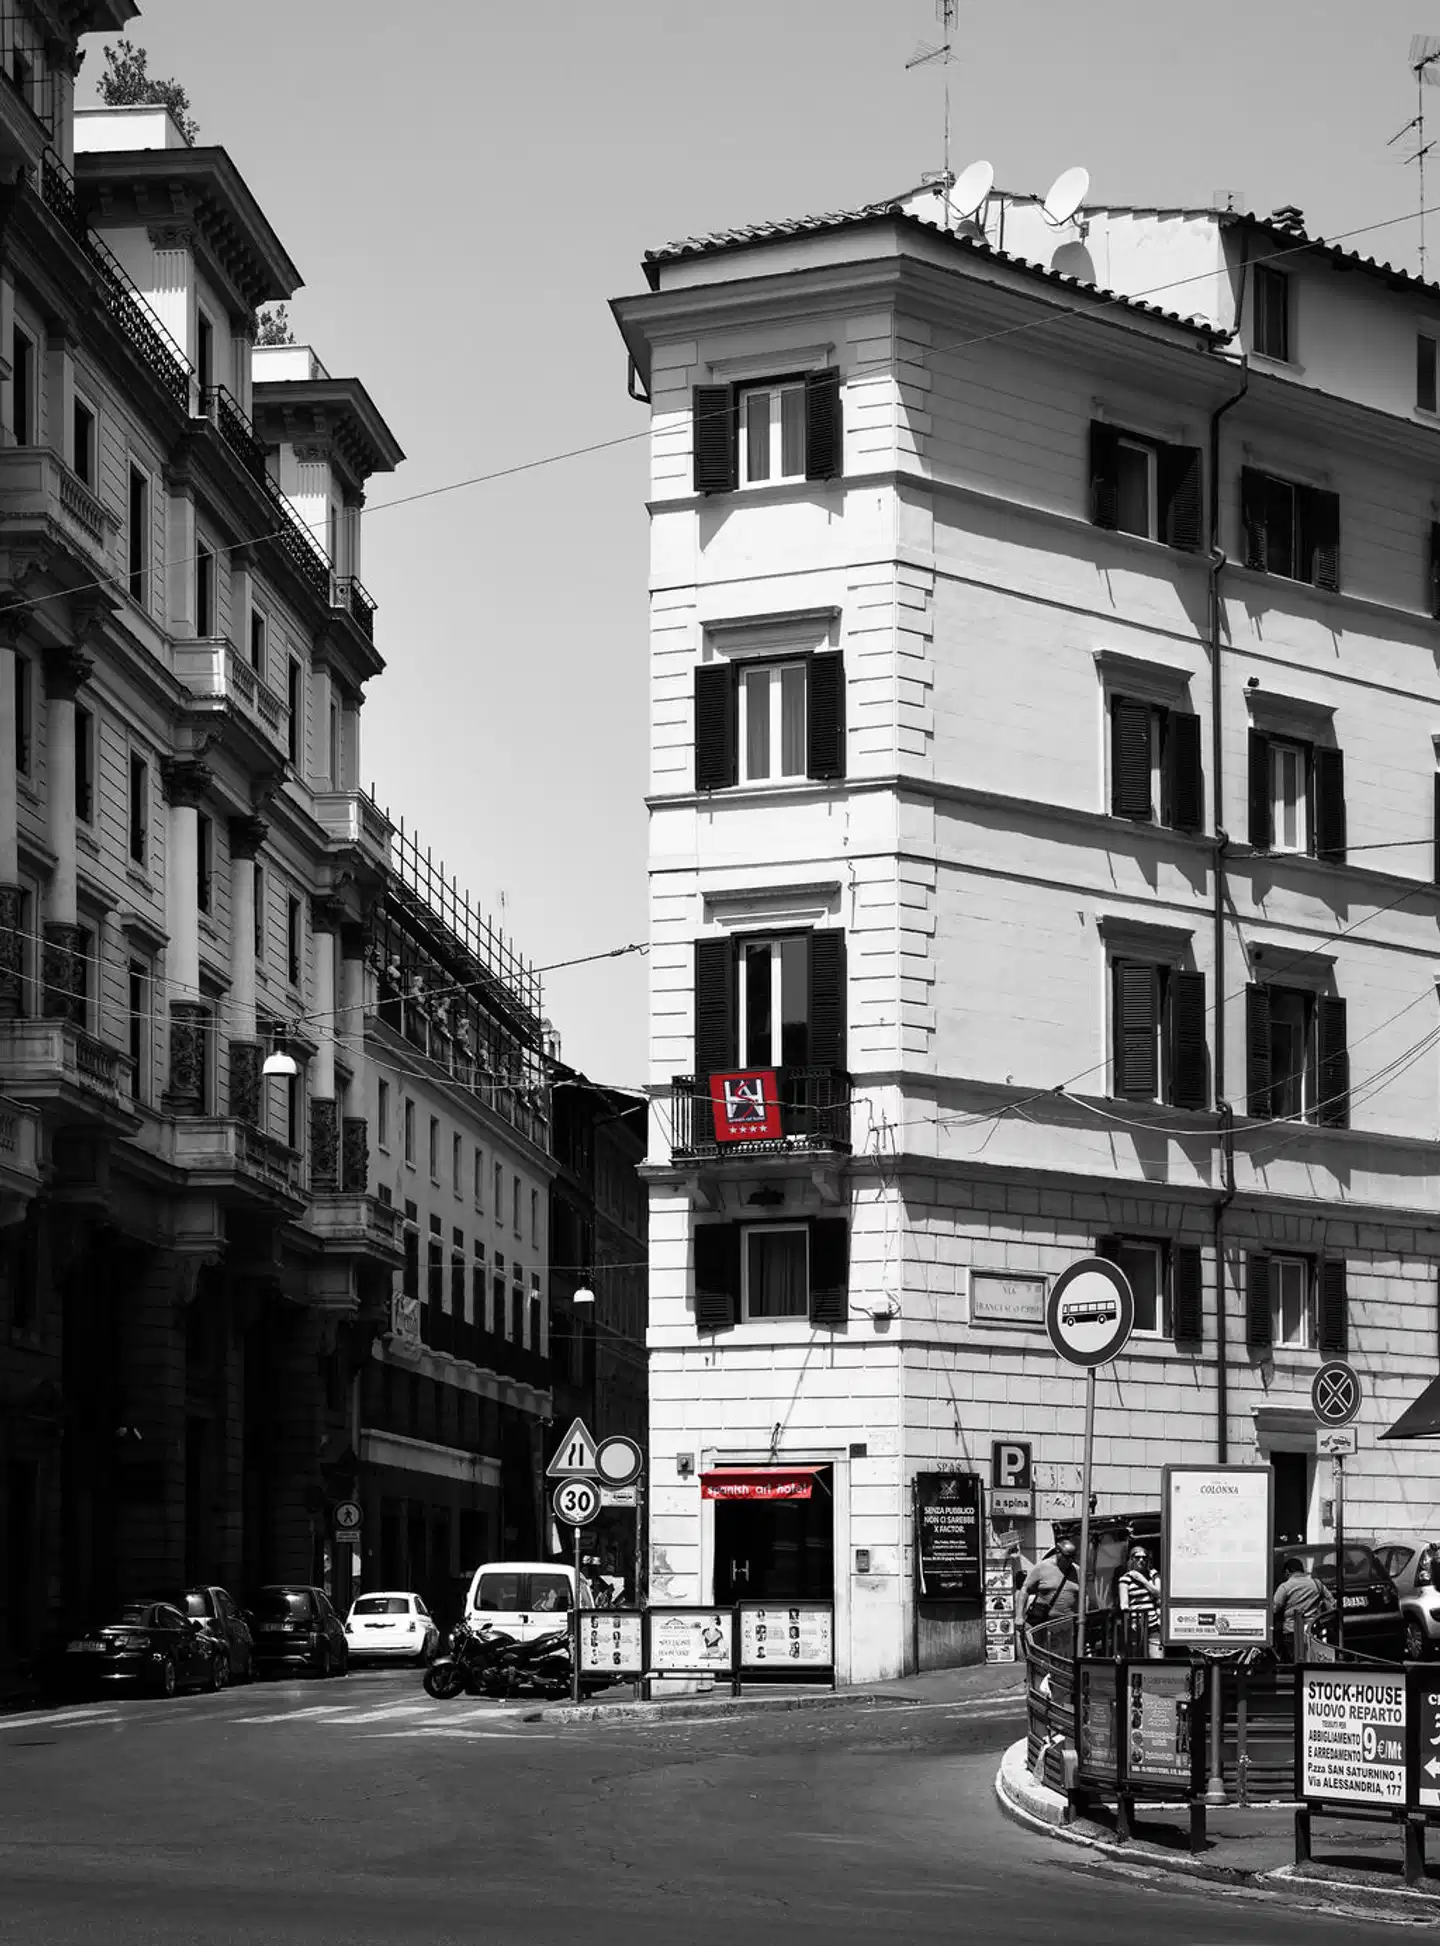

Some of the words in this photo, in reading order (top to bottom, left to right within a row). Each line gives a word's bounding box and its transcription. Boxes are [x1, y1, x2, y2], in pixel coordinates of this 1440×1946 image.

[1001, 1446, 1025, 1486] P
[707, 1484, 750, 1497] spanish
[755, 1483, 772, 1495] art
[776, 1481, 808, 1495] hotel
[1200, 1485, 1239, 1495] COLONNA
[565, 1490, 591, 1512] 30
[924, 1506, 945, 1515] SENZA
[945, 1506, 976, 1515] PUBBLICO
[924, 1515, 940, 1524] NON
[946, 1515, 975, 1524] SAREBBE
[1308, 1681, 1402, 1706] STOCK-HOUSE
[1307, 1702, 1346, 1719] NUOVO
[1349, 1705, 1402, 1723] REPARTO
[1309, 1729, 1361, 1746] ABBIGLIAMENTO
[1363, 1726, 1377, 1761] 9
[1308, 1746, 1313, 1758] E
[1313, 1747, 1361, 1763] ARREDAMENTO
[1308, 1762, 1326, 1774] P.zza
[1327, 1764, 1345, 1776] SAN
[1346, 1766, 1395, 1781] SATURNINO
[1308, 1776, 1321, 1787] Via
[1323, 1777, 1384, 1796] ALESSANDRIA,
[1387, 1784, 1402, 1796] 177
